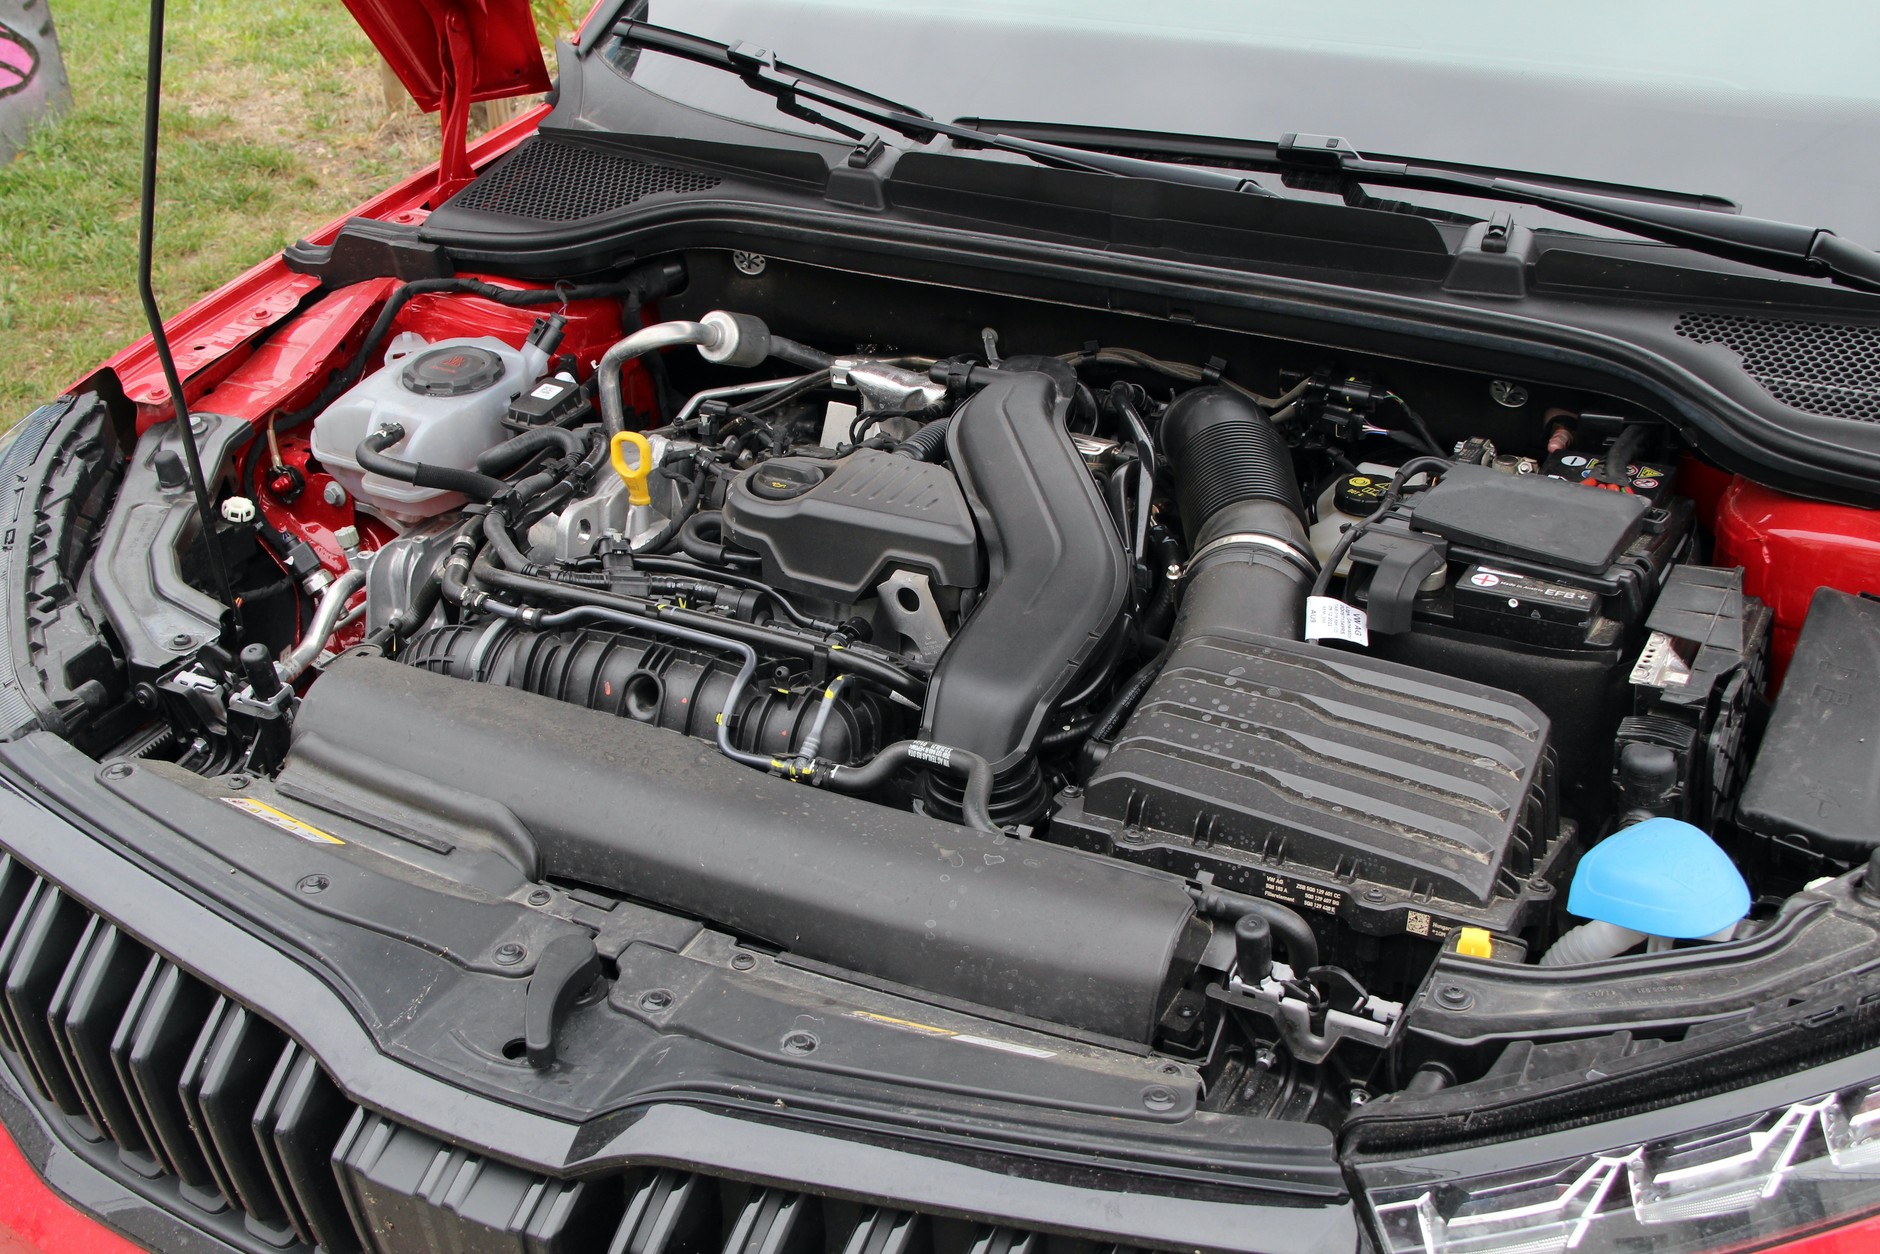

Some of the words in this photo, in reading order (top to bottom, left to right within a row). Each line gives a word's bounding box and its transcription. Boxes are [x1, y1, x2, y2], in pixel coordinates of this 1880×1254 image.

[1544, 588, 1575, 599] EFB
[1353, 613, 1361, 624] VW
[1354, 625, 1362, 637] AG
